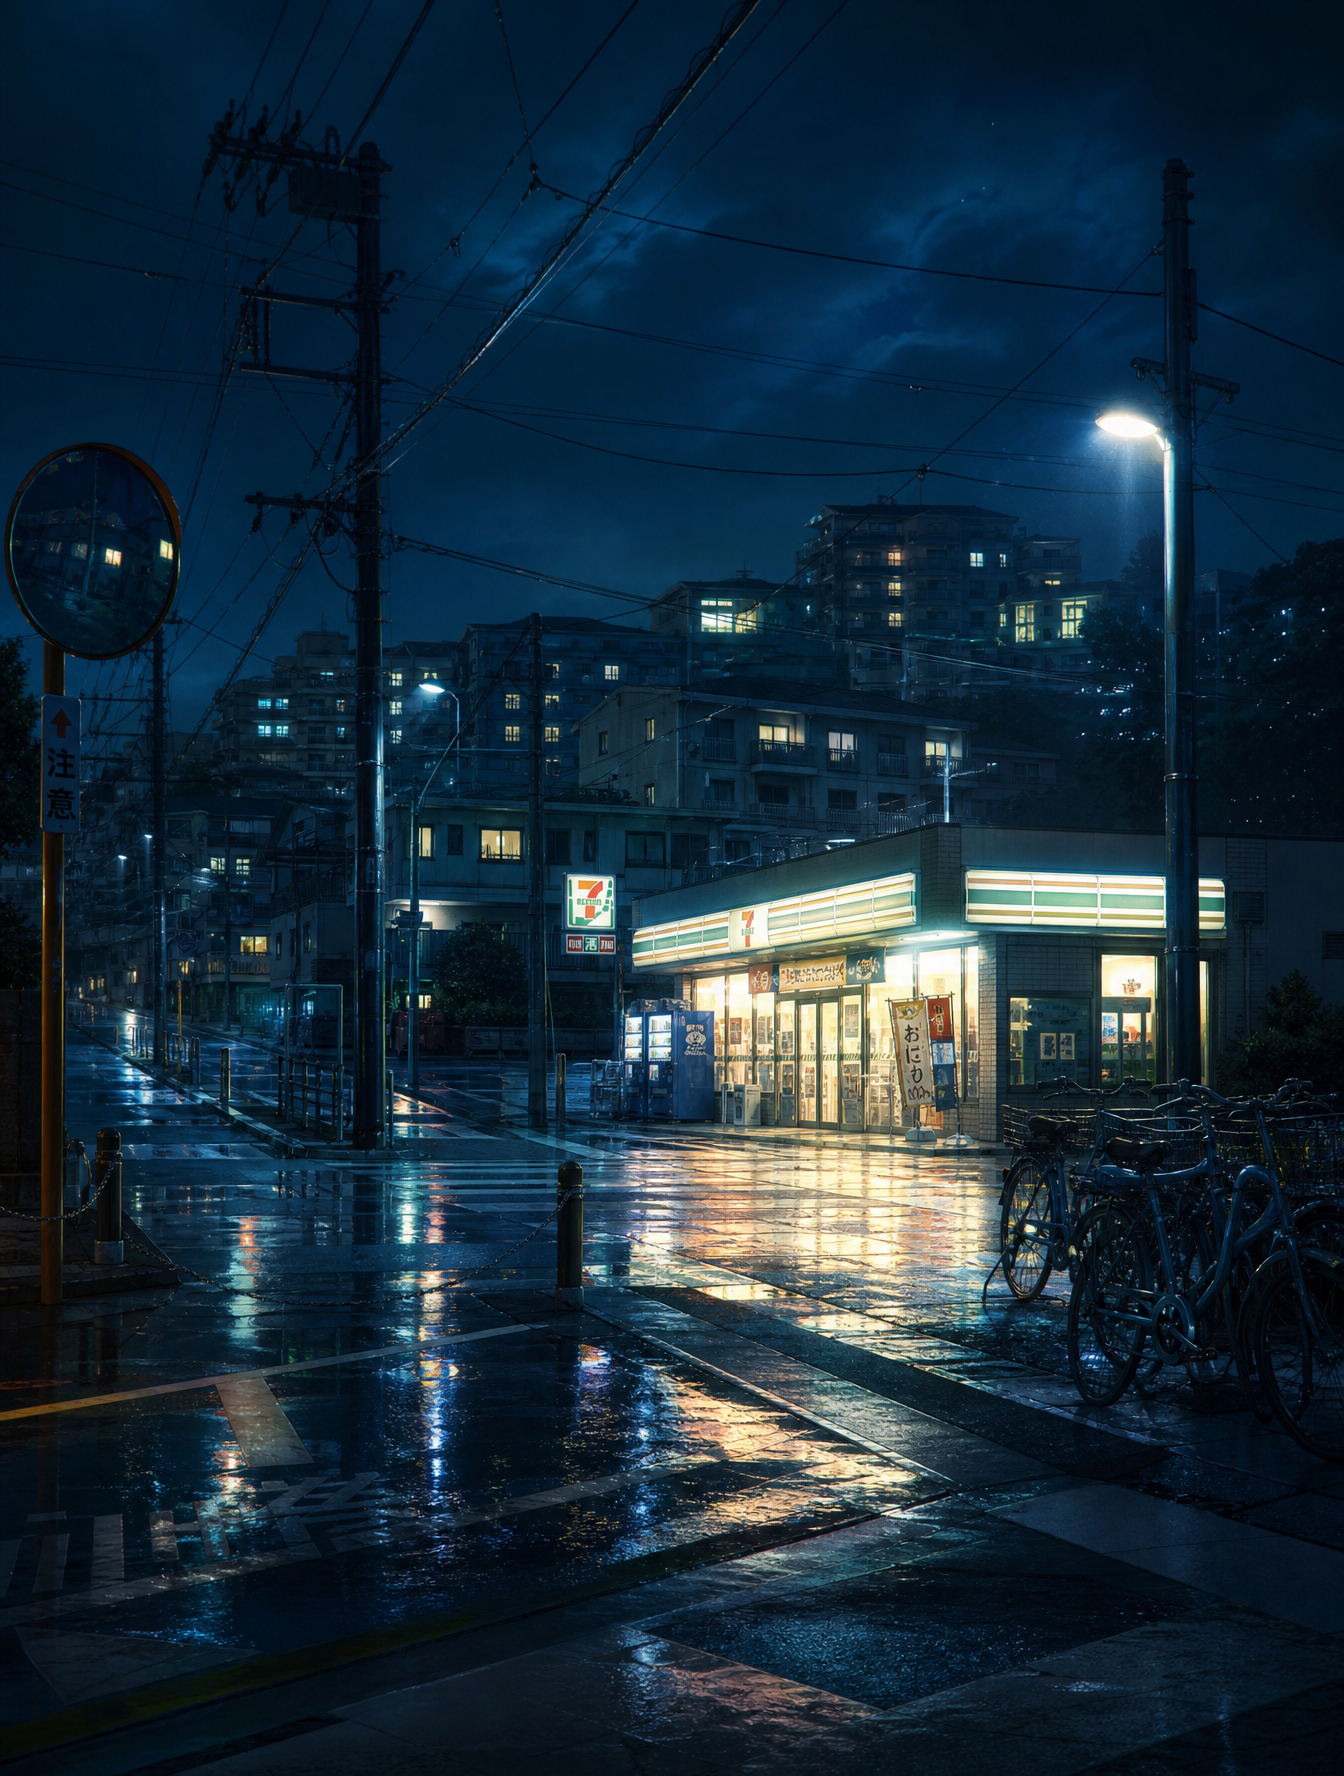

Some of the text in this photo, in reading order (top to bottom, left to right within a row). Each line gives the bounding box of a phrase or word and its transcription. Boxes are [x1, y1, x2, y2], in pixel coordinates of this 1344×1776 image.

[47, 747, 76, 820] 注意
[578, 880, 603, 918] 7
[741, 910, 755, 947] 7
